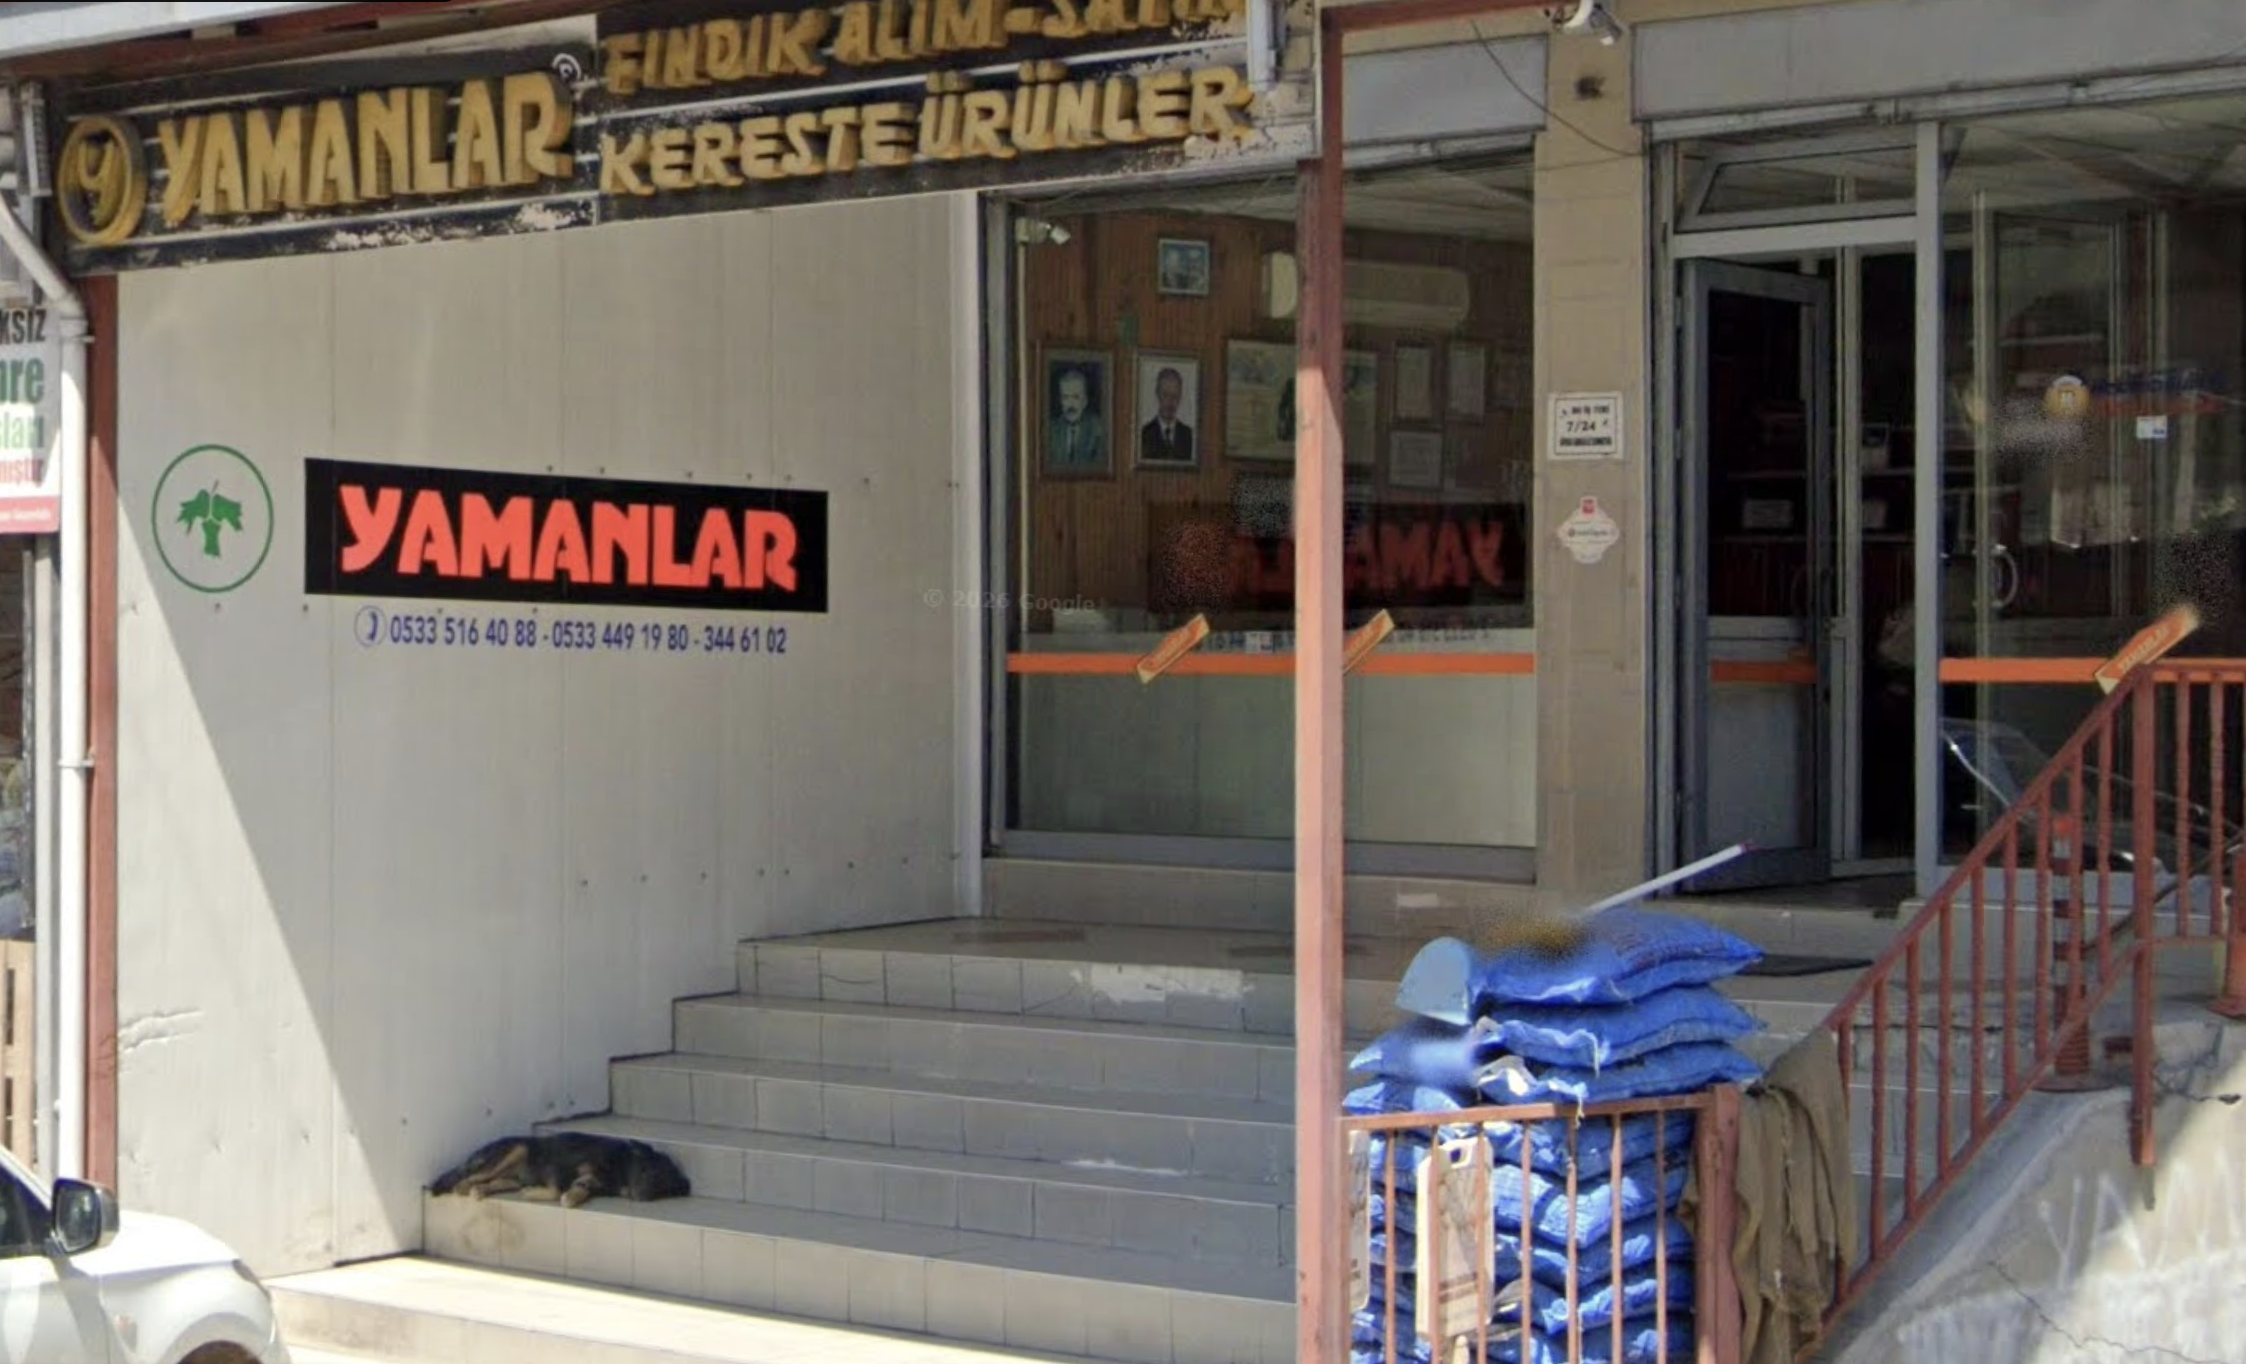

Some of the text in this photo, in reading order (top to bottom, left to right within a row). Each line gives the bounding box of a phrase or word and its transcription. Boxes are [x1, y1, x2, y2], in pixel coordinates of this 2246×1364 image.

[604, 9, 827, 95] FINDIK
[157, 71, 574, 228] YAMANLAR
[600, 59, 1254, 197] KERESTE ÜRÜNLER
[340, 484, 797, 592] YAMANLAR
[390, 615, 437, 645] 0533
[444, 617, 479, 646] 516
[485, 618, 509, 647] 40
[514, 619, 537, 648] 88
[551, 620, 596, 650] 0533
[601, 622, 635, 650] 449
[640, 623, 663, 651] 19
[667, 624, 690, 652] 80
[703, 625, 736, 653] 344
[739, 626, 760, 654] 61
[765, 627, 788, 656] 02
